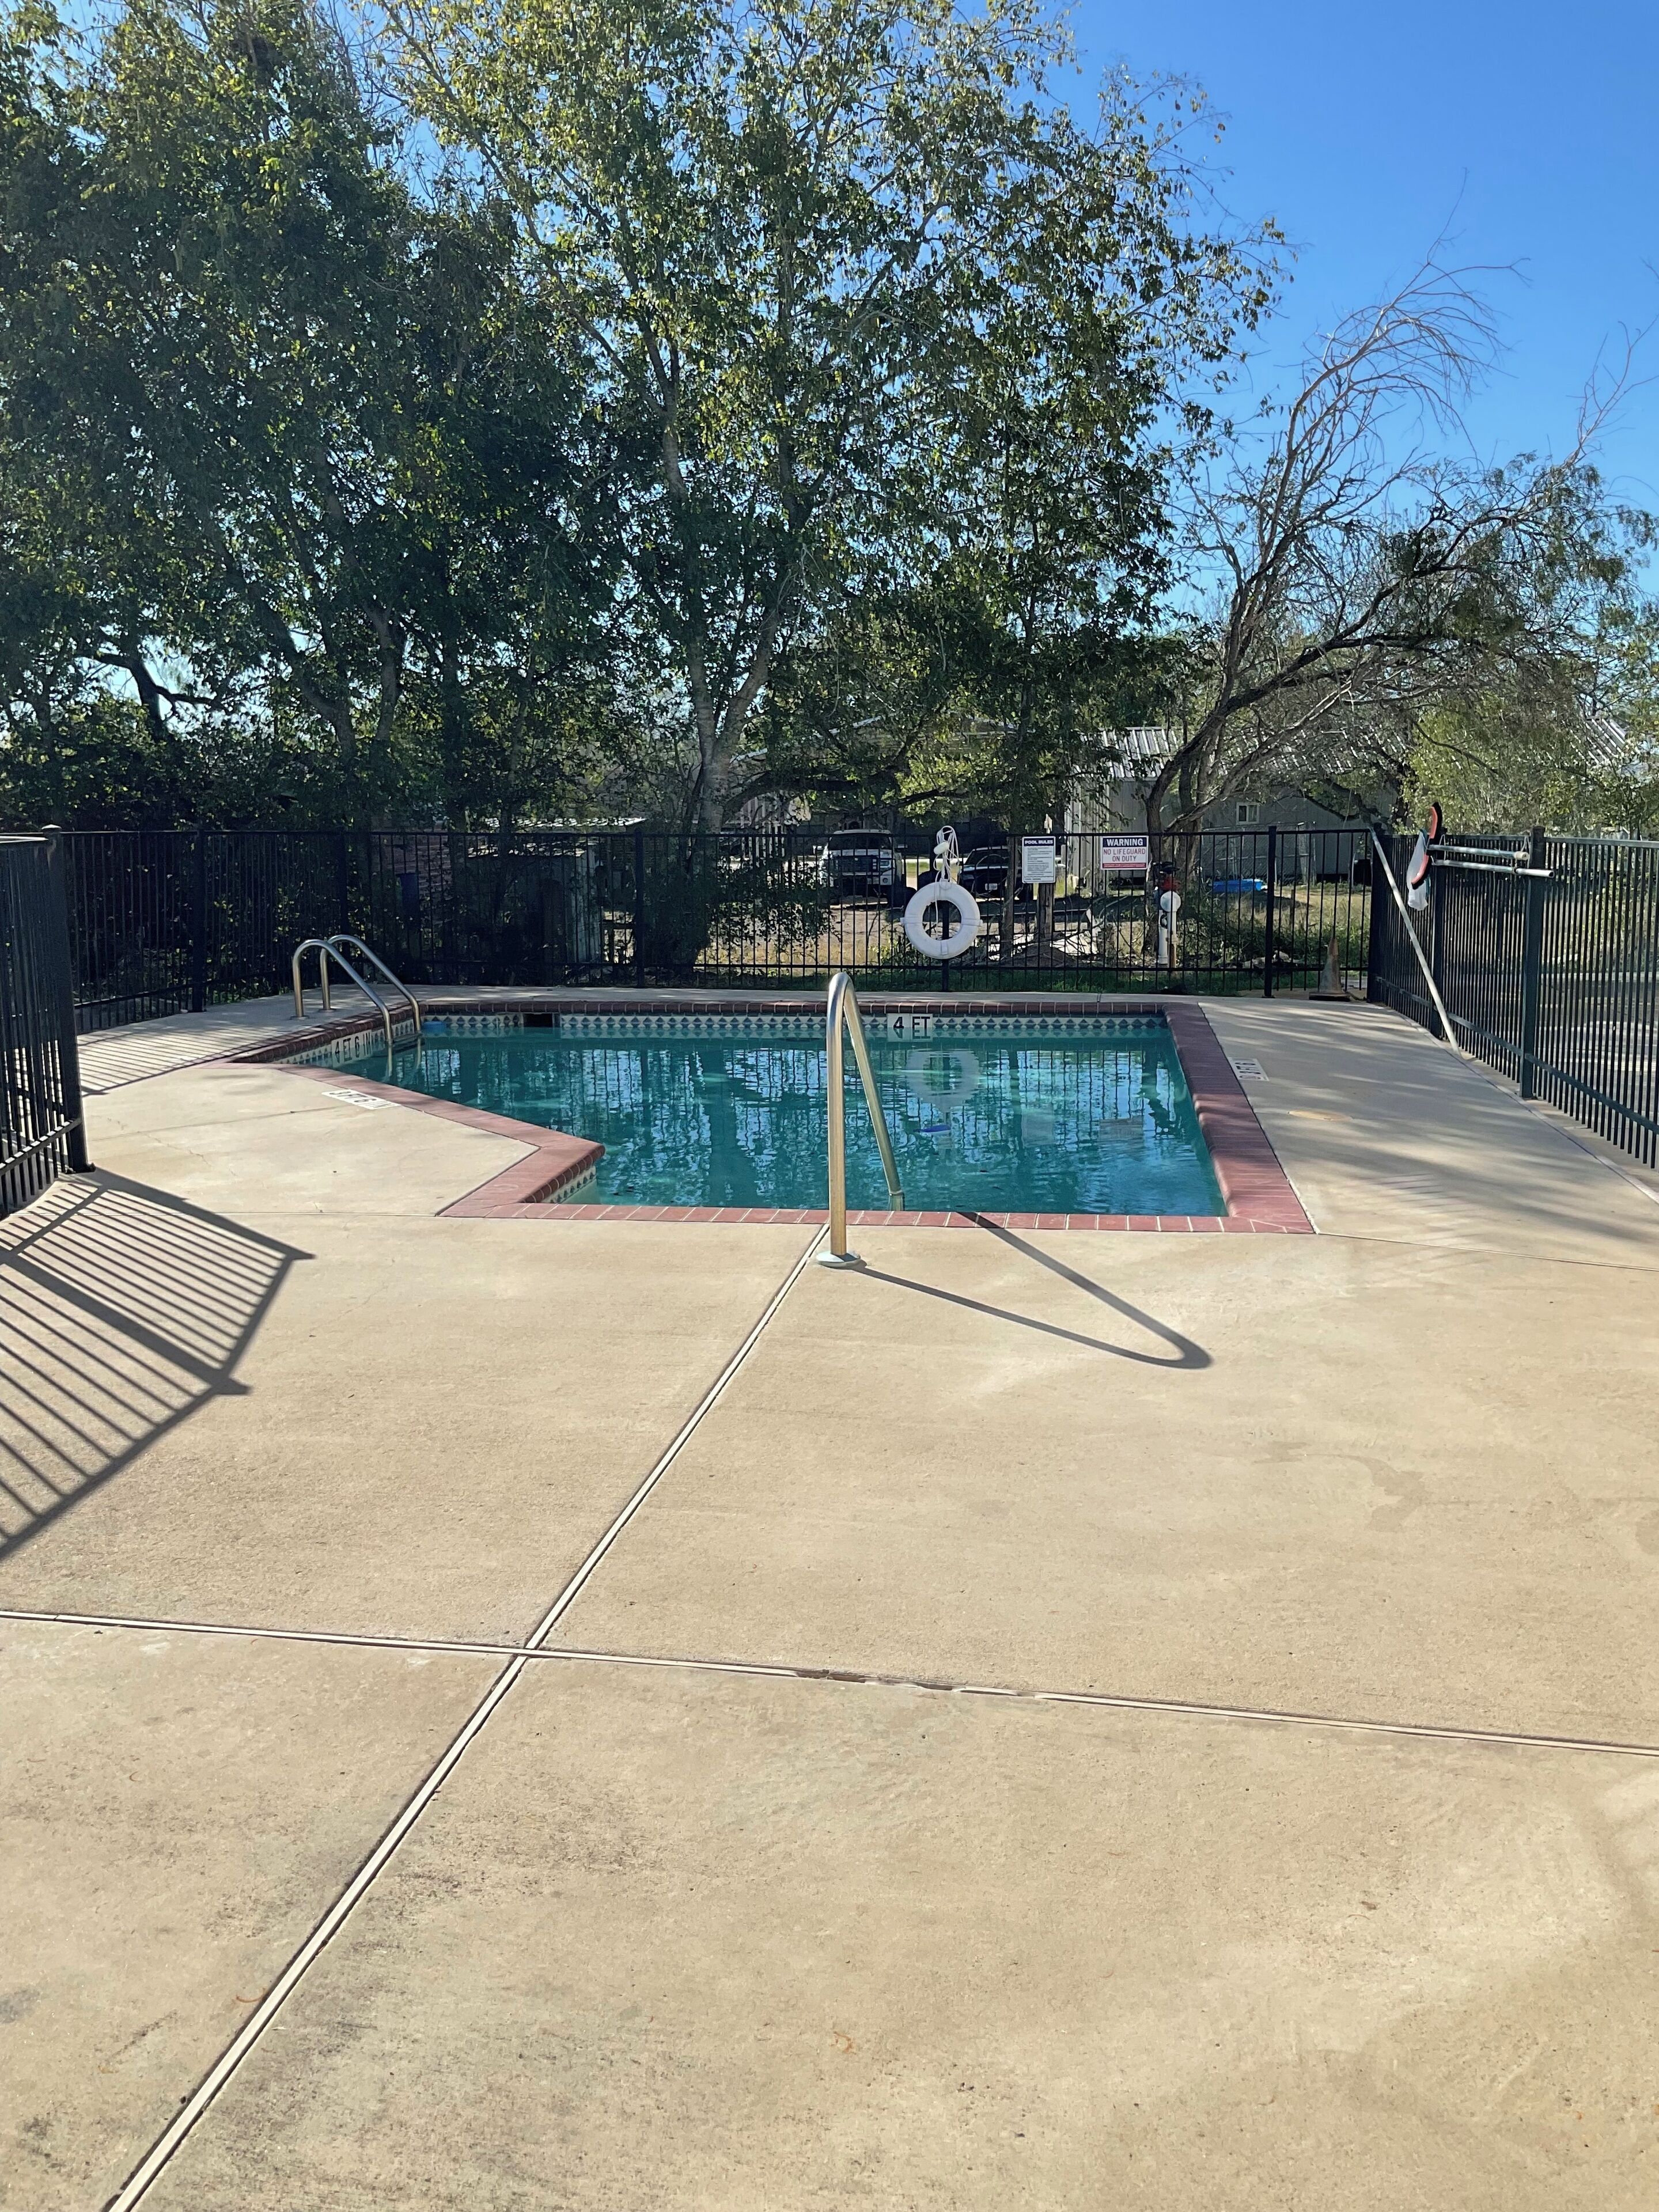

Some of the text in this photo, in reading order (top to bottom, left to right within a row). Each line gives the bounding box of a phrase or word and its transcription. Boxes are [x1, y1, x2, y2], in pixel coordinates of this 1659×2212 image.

[1107, 838, 1143, 846] WARNING
[893, 1016, 931, 1029] 4 FT
[335, 1041, 340, 1055] 4
[343, 1037, 351, 1052] FT
